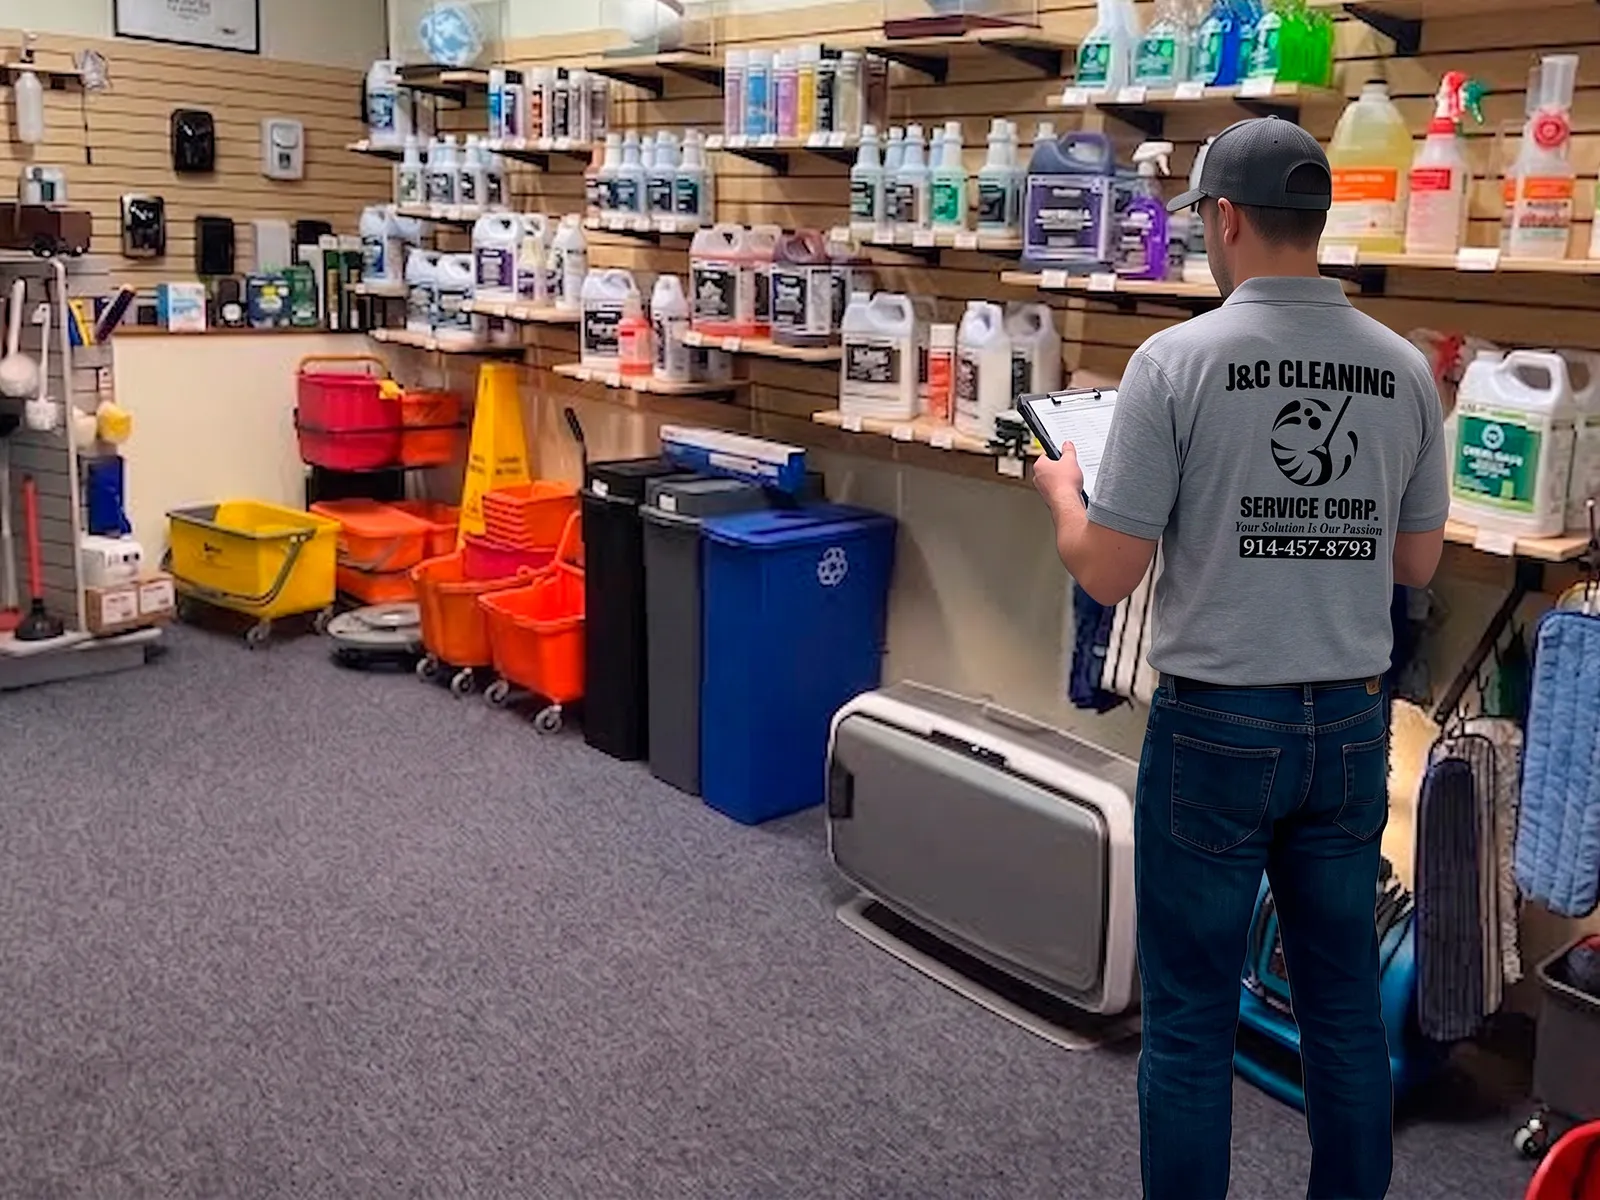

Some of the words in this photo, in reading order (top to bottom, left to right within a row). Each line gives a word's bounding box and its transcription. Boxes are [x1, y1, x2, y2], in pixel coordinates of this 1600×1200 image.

[1225, 359, 1271, 392] J&C
[1278, 359, 1396, 399] CLEANING
[1240, 496, 1319, 519] SERVICE
[1323, 497, 1379, 521] CORP.
[1235, 521, 1260, 533] Your
[1261, 521, 1305, 533] Solution
[1307, 522, 1318, 534] Is
[1320, 523, 1341, 535] Our
[1342, 523, 1383, 537] Passion
[1243, 539, 1372, 558] 914-457-8793
